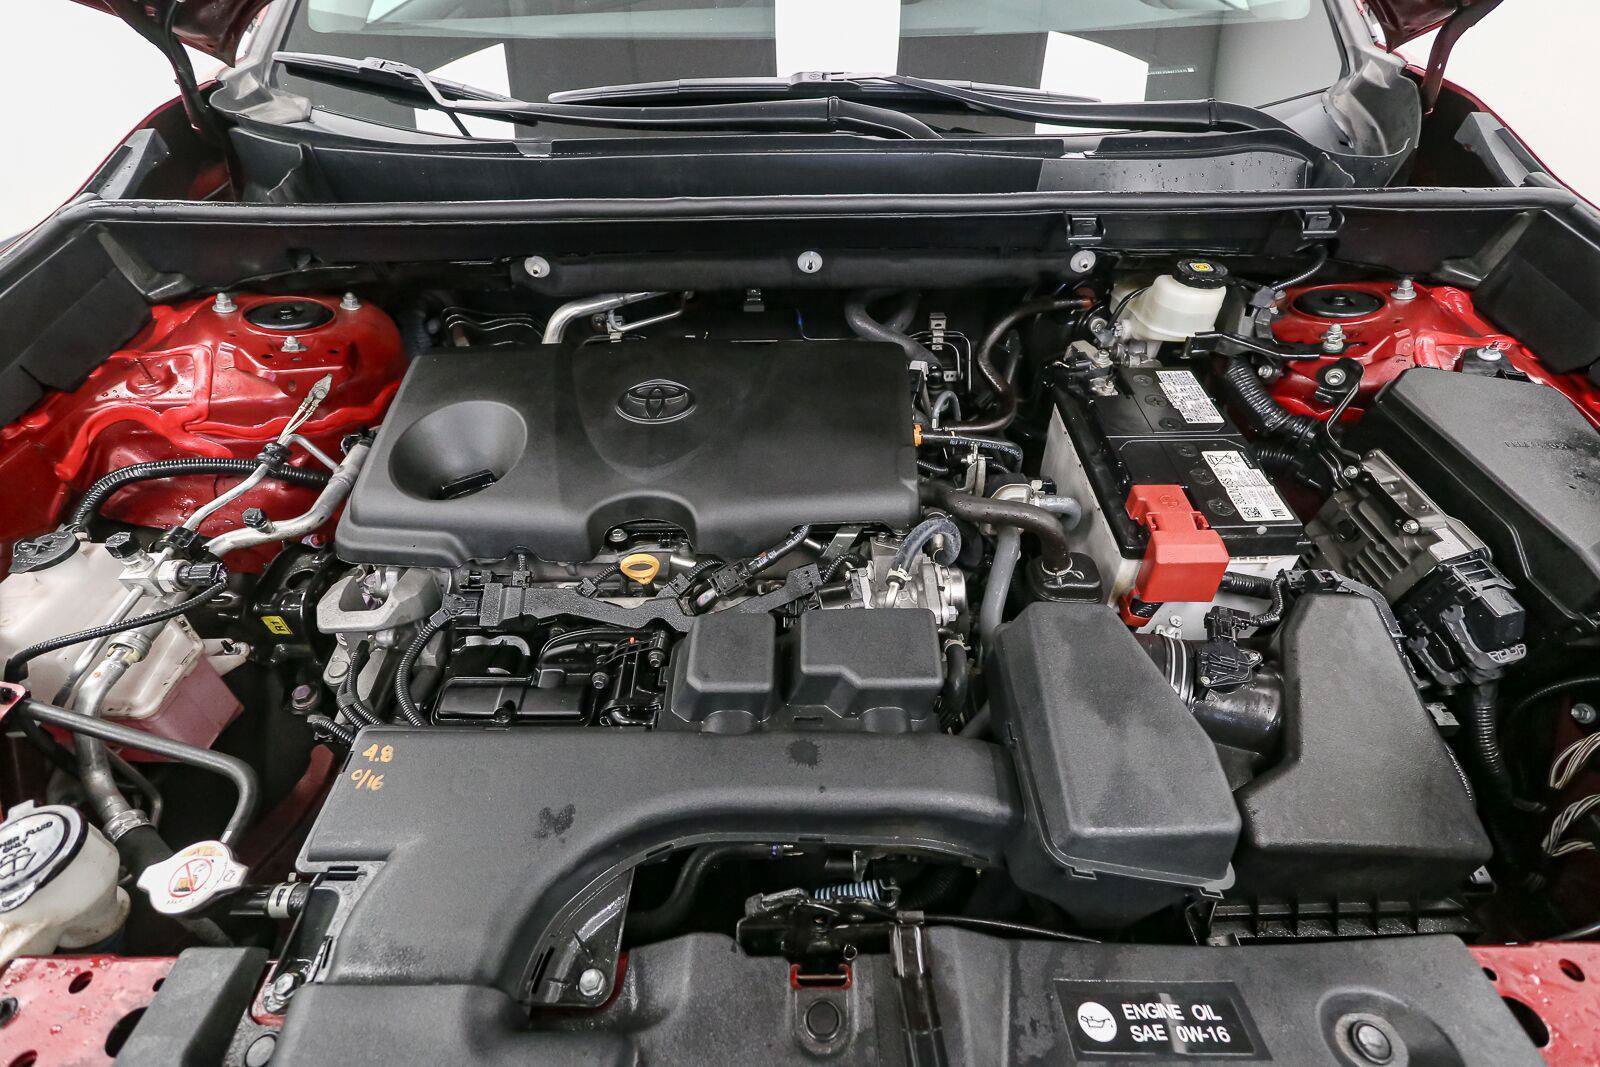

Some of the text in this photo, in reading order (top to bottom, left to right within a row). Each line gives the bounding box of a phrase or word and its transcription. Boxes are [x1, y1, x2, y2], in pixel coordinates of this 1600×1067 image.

[362, 743, 394, 763] 4.8
[26, 821, 53, 838] FLUID
[1121, 1003, 1222, 1021] ENGINE OIL
[1130, 1024, 1231, 1043] SAE 0W-16
